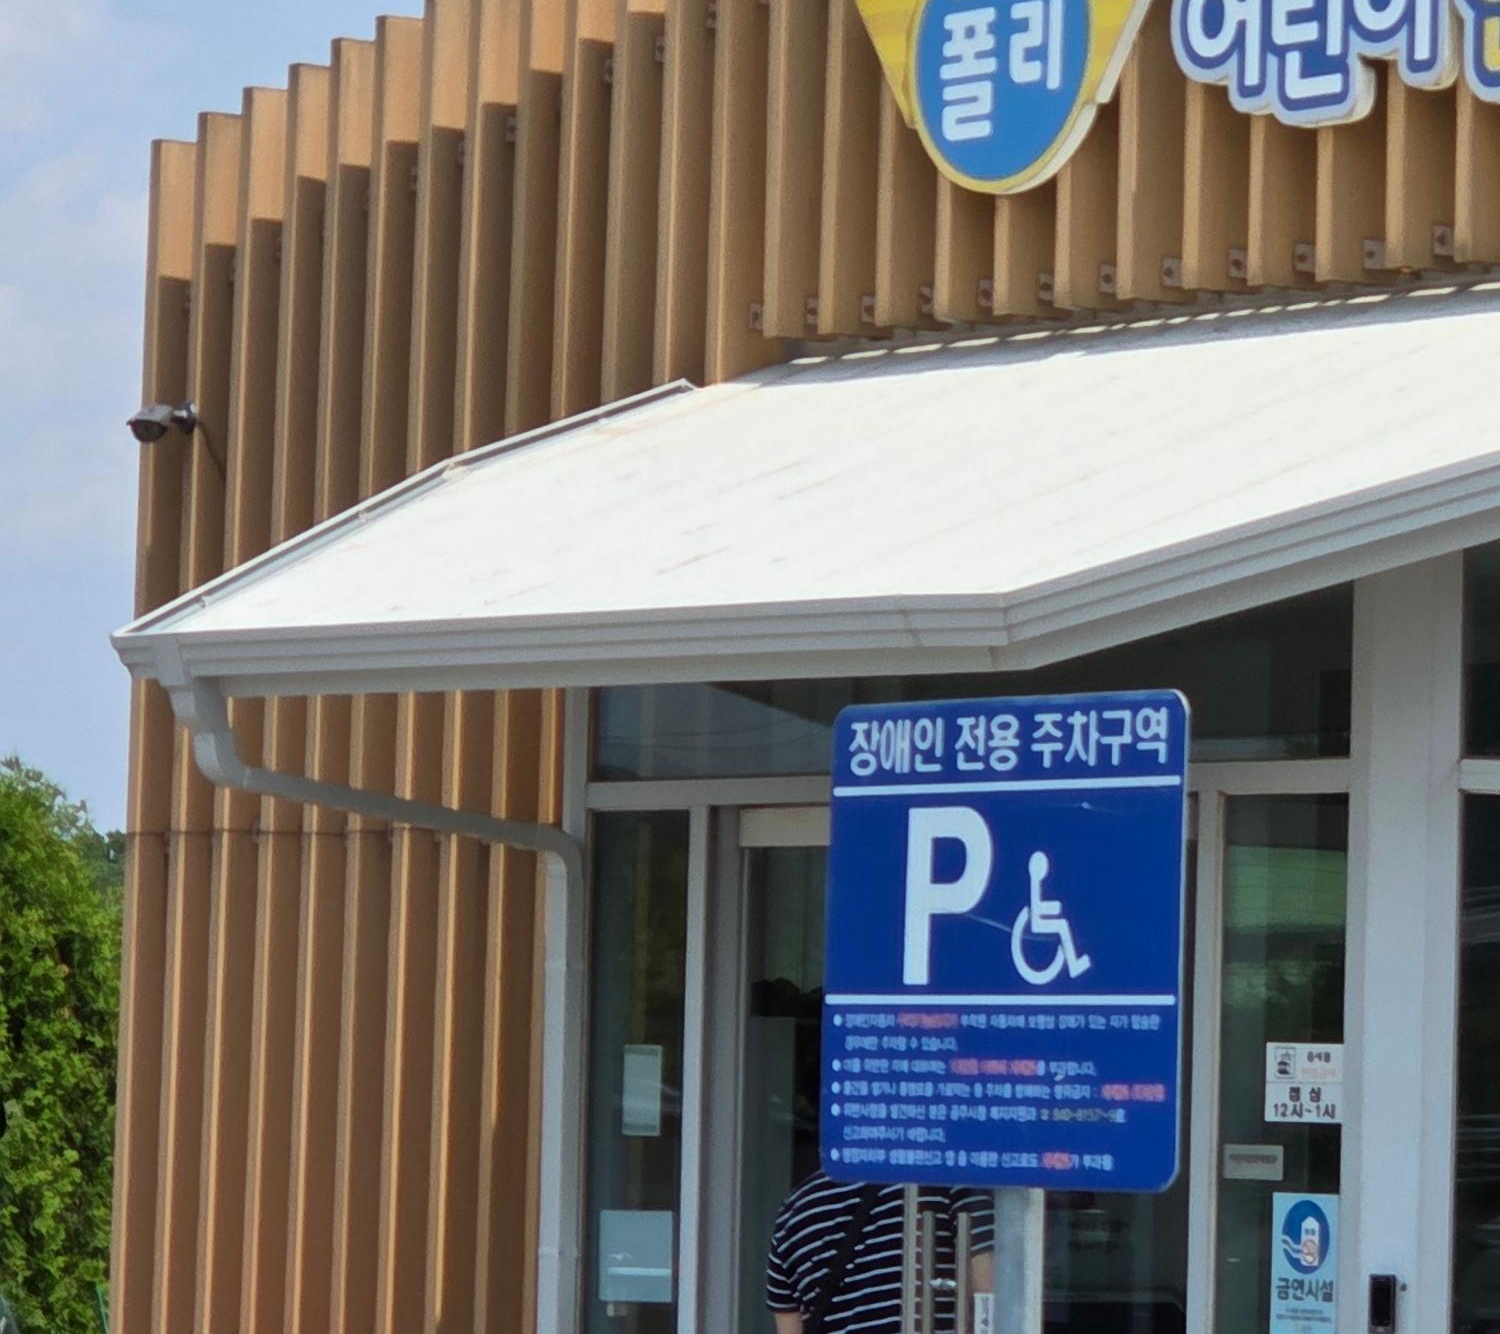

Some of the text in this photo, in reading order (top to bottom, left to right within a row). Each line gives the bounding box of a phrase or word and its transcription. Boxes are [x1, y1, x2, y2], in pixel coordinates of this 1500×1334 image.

[849, 707, 1168, 776] 장애인 전용 주차구역
[903, 806, 992, 985] P
[1276, 1277, 1334, 1303] 금연시설
